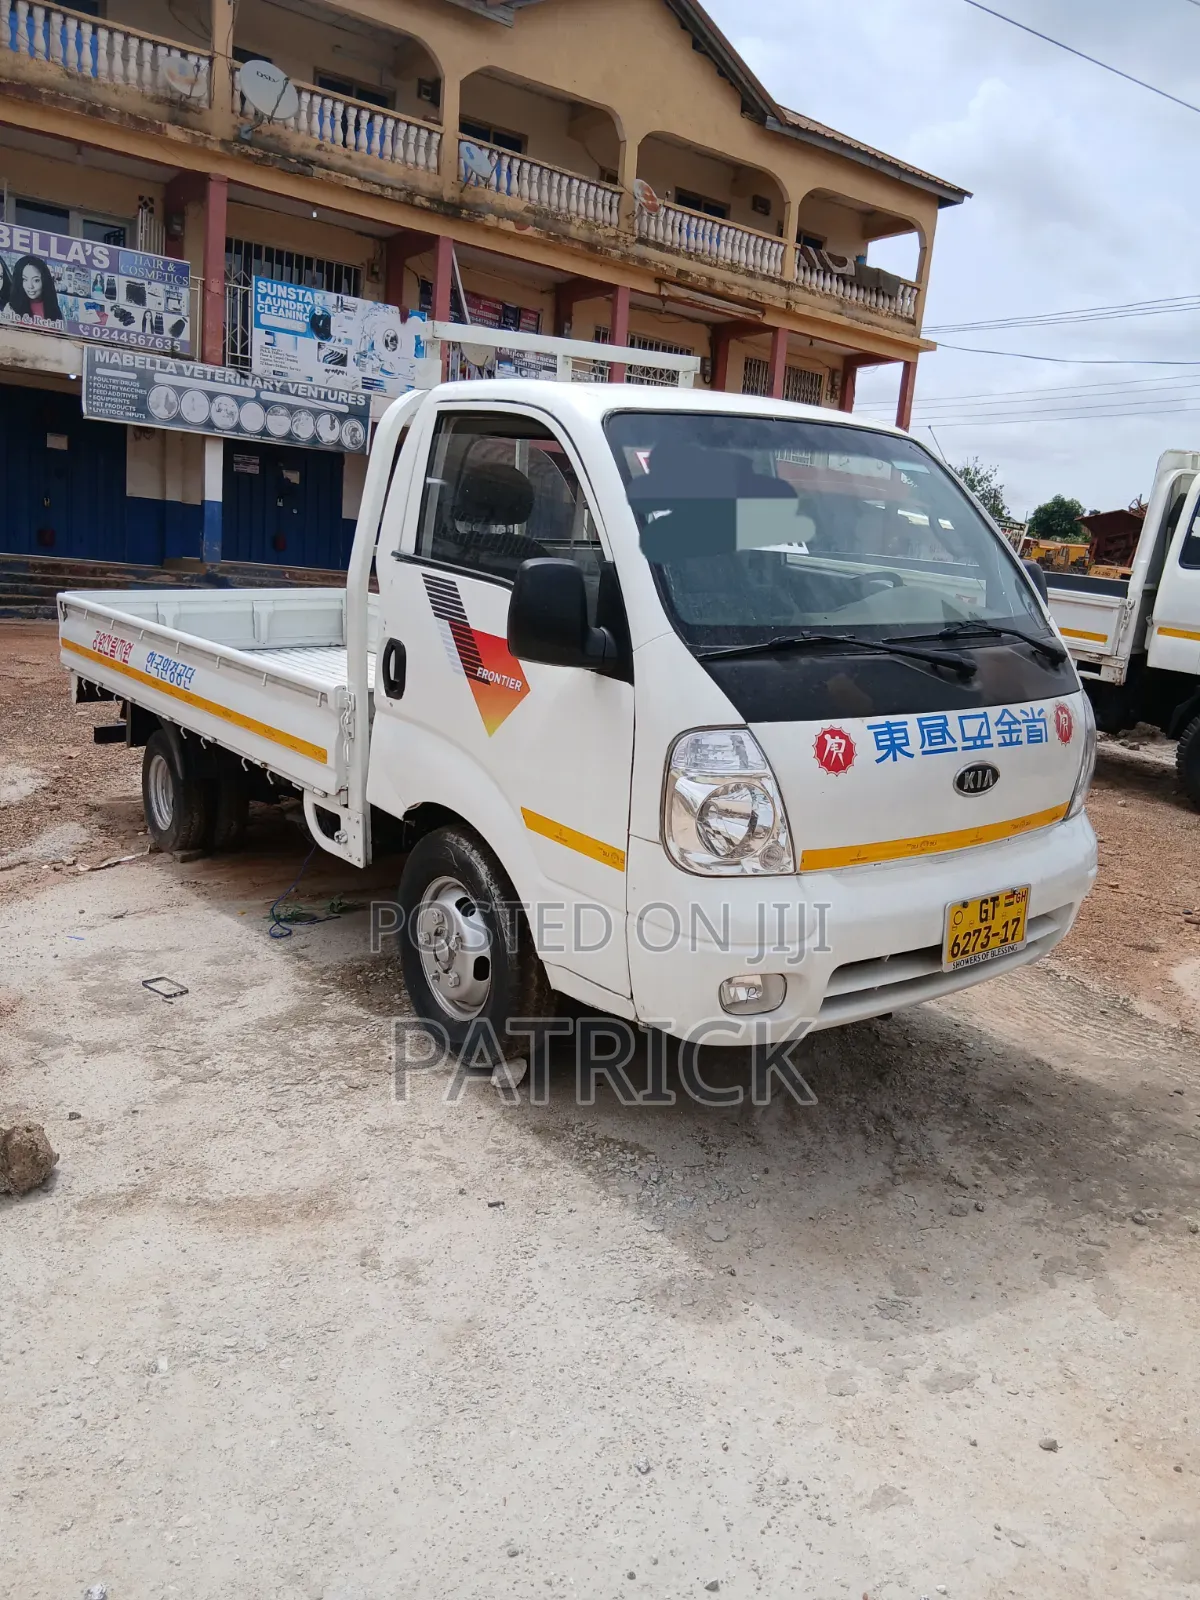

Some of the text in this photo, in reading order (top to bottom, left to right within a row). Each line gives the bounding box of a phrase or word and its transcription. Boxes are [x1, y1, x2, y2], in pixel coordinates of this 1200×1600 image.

[134, 255, 177, 272] HAIR &
[120, 265, 189, 286] COSMETICS
[257, 281, 324, 306] SUNSTAR
[257, 294, 312, 314] LAUNDRY
[34, 315, 65, 330] Retail
[257, 303, 310, 322] CLEANING
[94, 349, 178, 374] MABELLA
[181, 363, 286, 392] VETERINARY
[287, 383, 366, 406] VENTURES
[476, 667, 522, 692] FRONTIER
[963, 769, 993, 790] KIA
[1015, 890, 1027, 904] GH
[979, 895, 999, 923] GT
[950, 917, 1021, 958] 6273-17
[952, 944, 1018, 970] SHOWERS OF BLESSING
